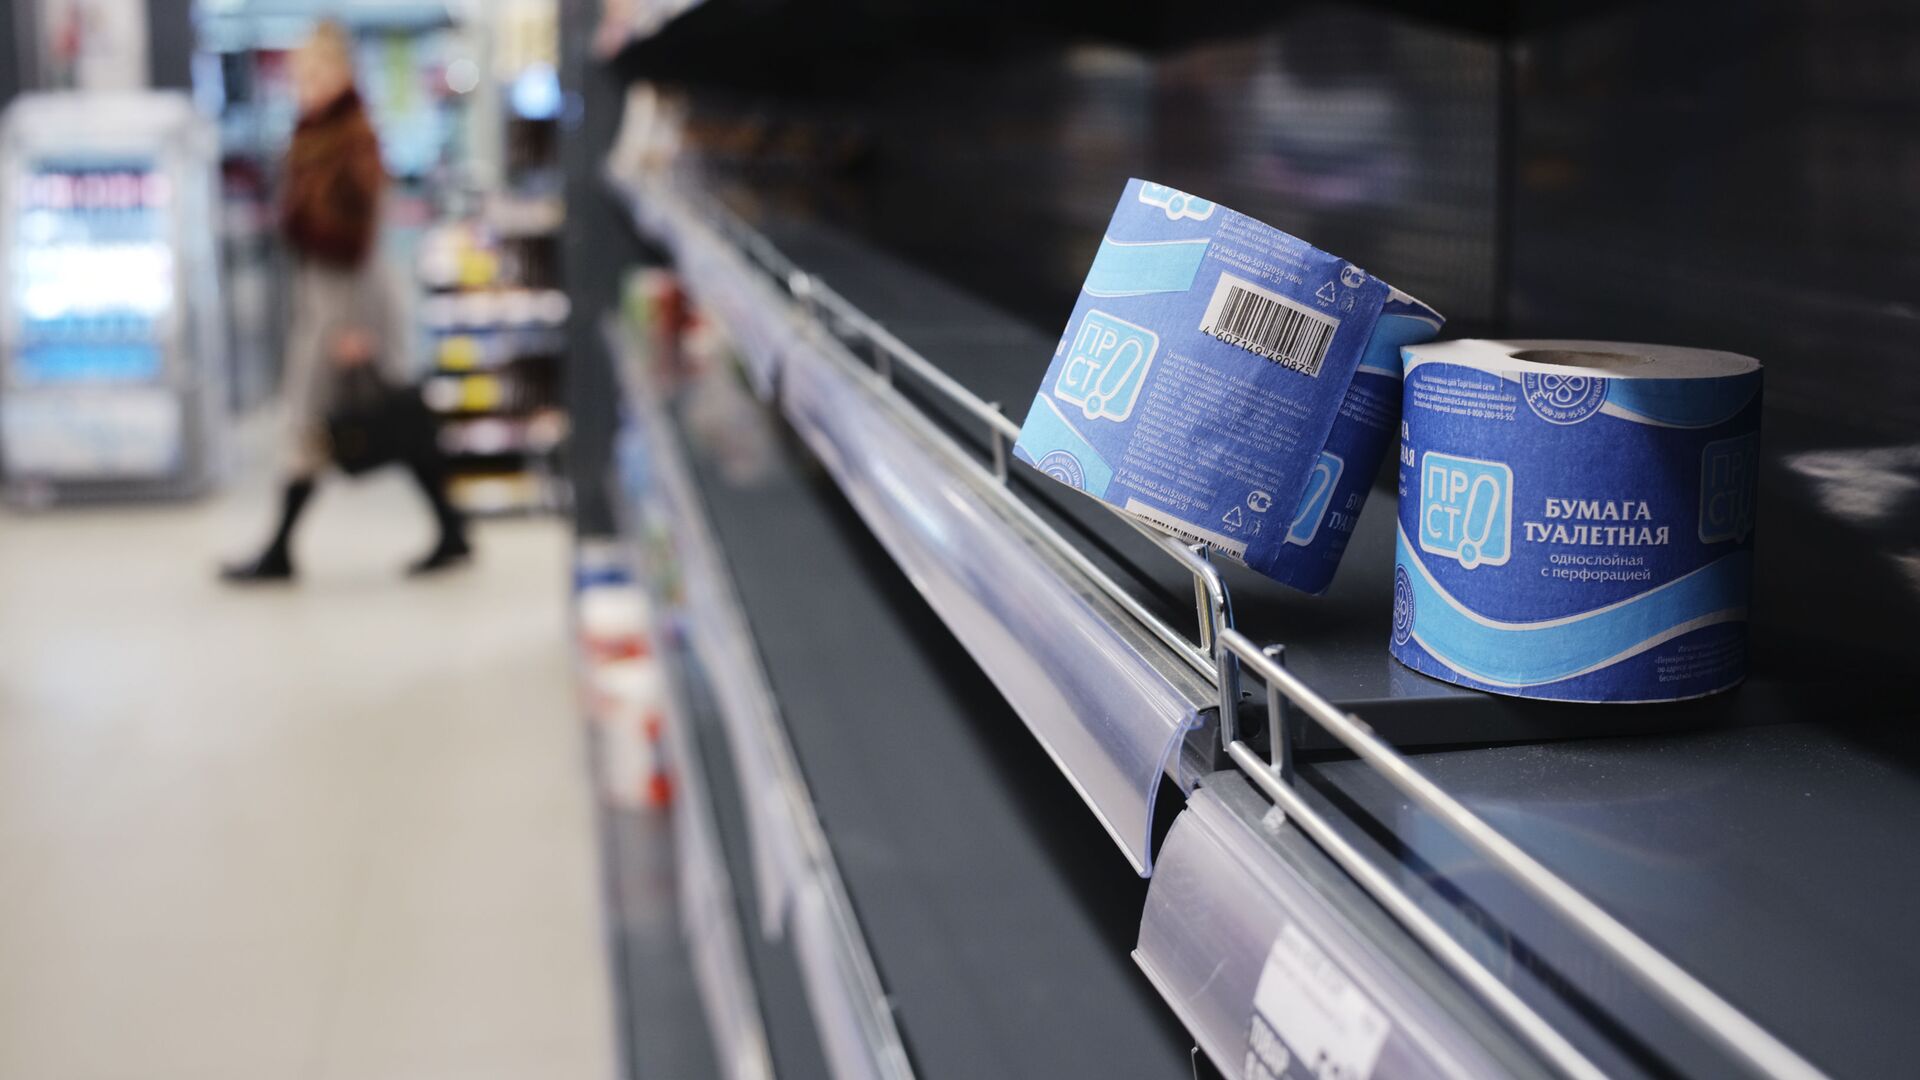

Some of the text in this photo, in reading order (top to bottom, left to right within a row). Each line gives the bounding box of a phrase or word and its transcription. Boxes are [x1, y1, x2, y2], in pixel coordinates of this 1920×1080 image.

[1211, 240, 1220, 250] ТУ
[1202, 325, 1312, 377] 4 607149 490875
[1117, 467, 1127, 477] ТУ
[1545, 498, 1652, 521] БУМАГА
[1523, 521, 1670, 546] ТУАЛЕТНАЯ
[1550, 553, 1644, 567] однослойная
[1541, 567, 1652, 582] с перфорацией
